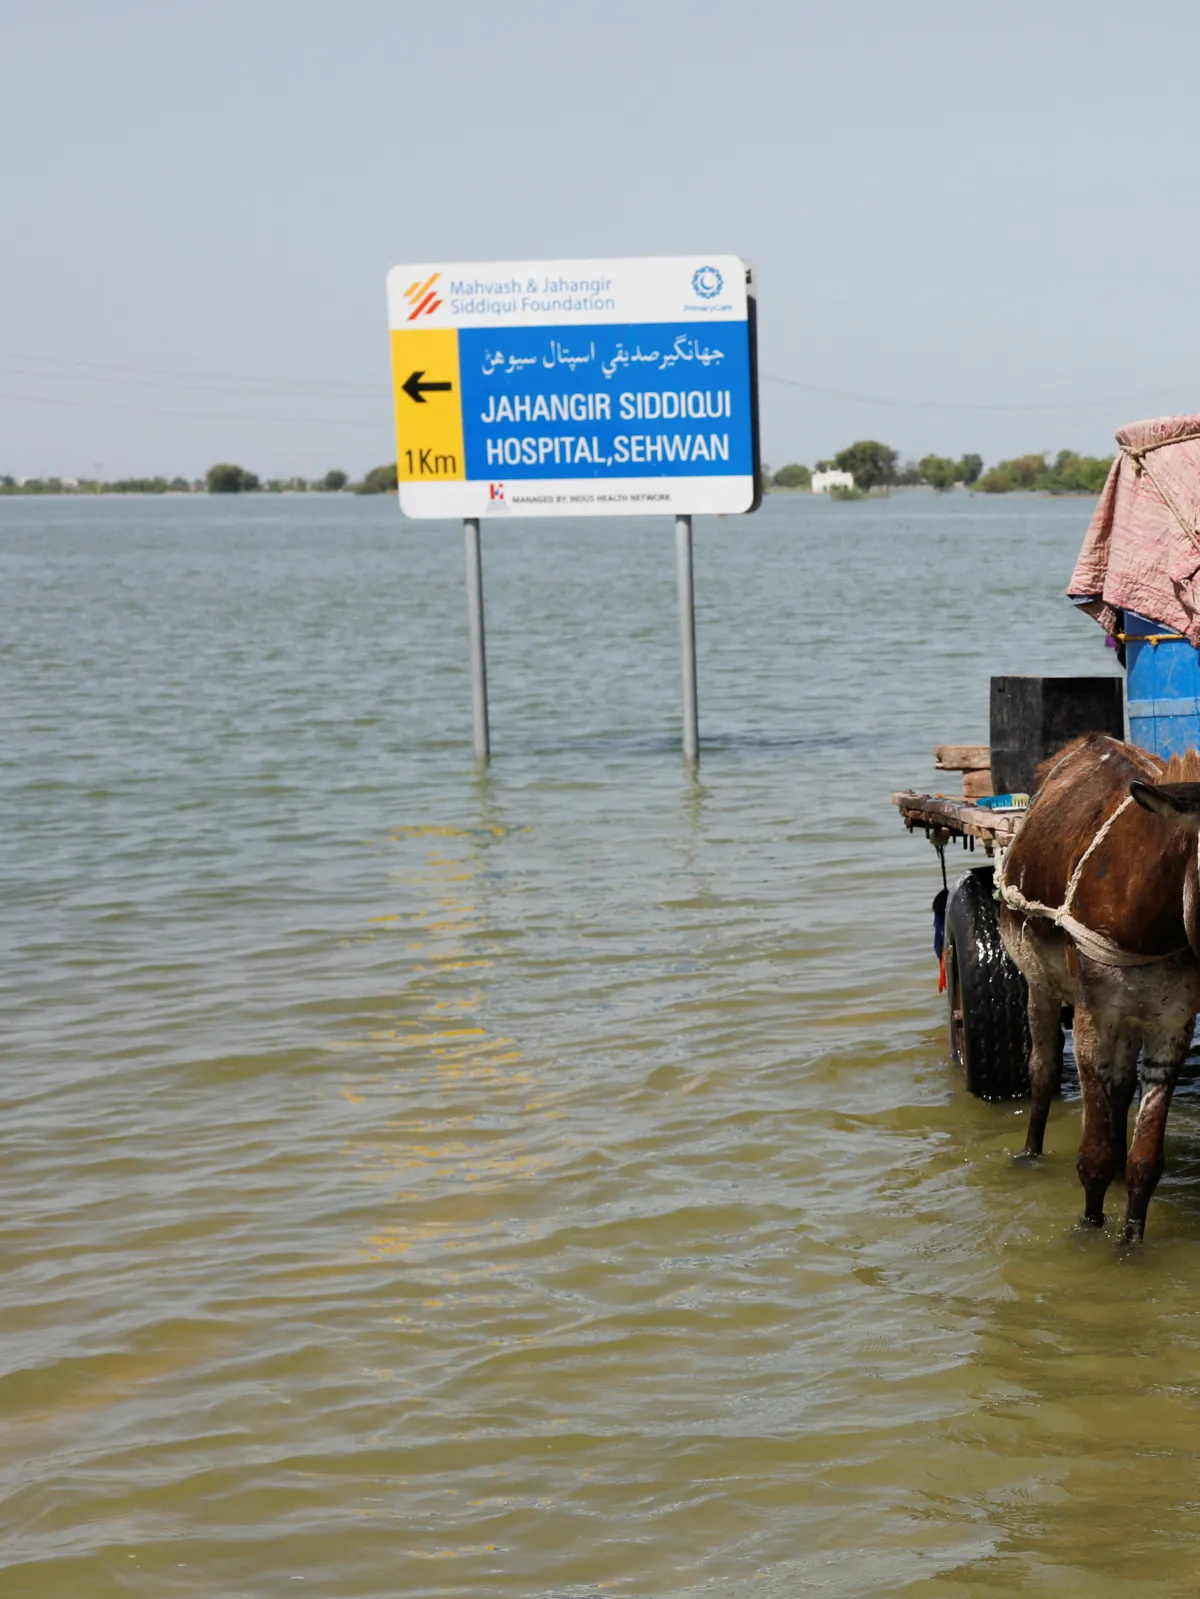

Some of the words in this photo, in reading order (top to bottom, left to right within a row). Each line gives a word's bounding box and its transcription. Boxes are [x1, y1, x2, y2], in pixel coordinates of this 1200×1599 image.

[450, 280, 521, 295] Mahvash
[527, 279, 538, 293] &
[542, 277, 612, 297] Jahangir
[450, 298, 517, 316] Siddiqui
[521, 296, 615, 312] Foundation
[481, 392, 611, 423] JAHANGIR
[619, 390, 732, 420] SIDDIQUI
[512, 495, 554, 504] MANAGED
[596, 494, 628, 502] HEALTH
[630, 493, 671, 502] NETWORK
